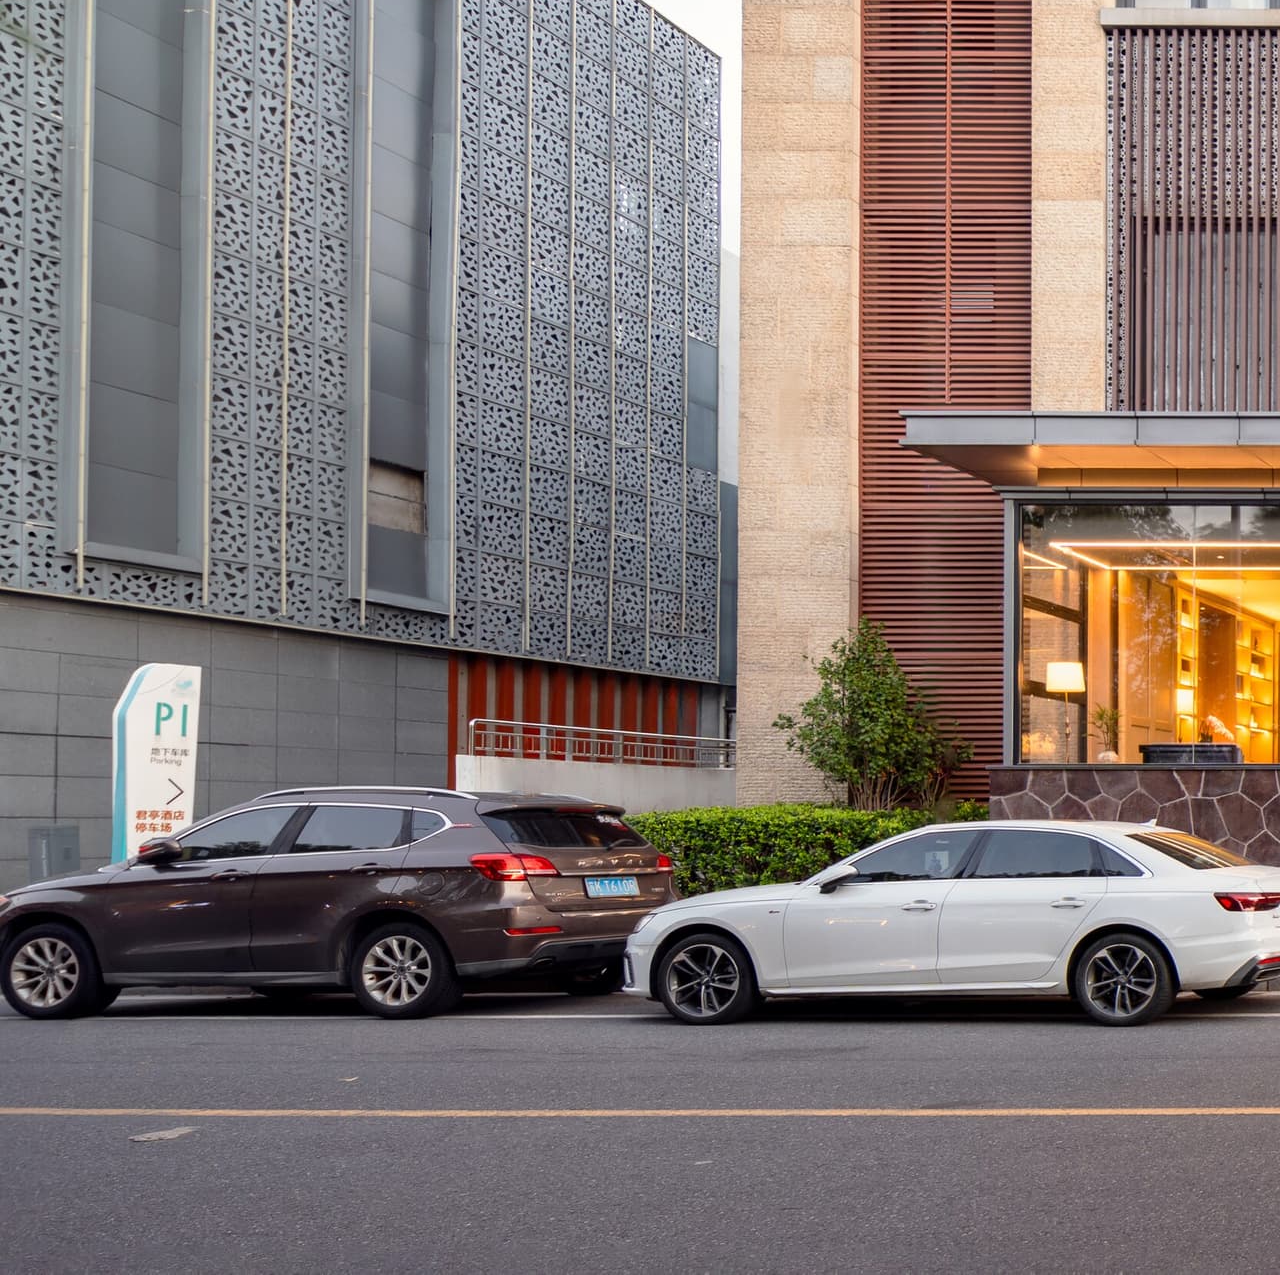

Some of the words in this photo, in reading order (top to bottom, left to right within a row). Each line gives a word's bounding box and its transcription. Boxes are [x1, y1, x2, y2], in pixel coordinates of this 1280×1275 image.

[150, 757, 182, 766] Parking
[136, 810, 185, 821] 君亭酒店
[135, 822, 173, 833] 停车场
